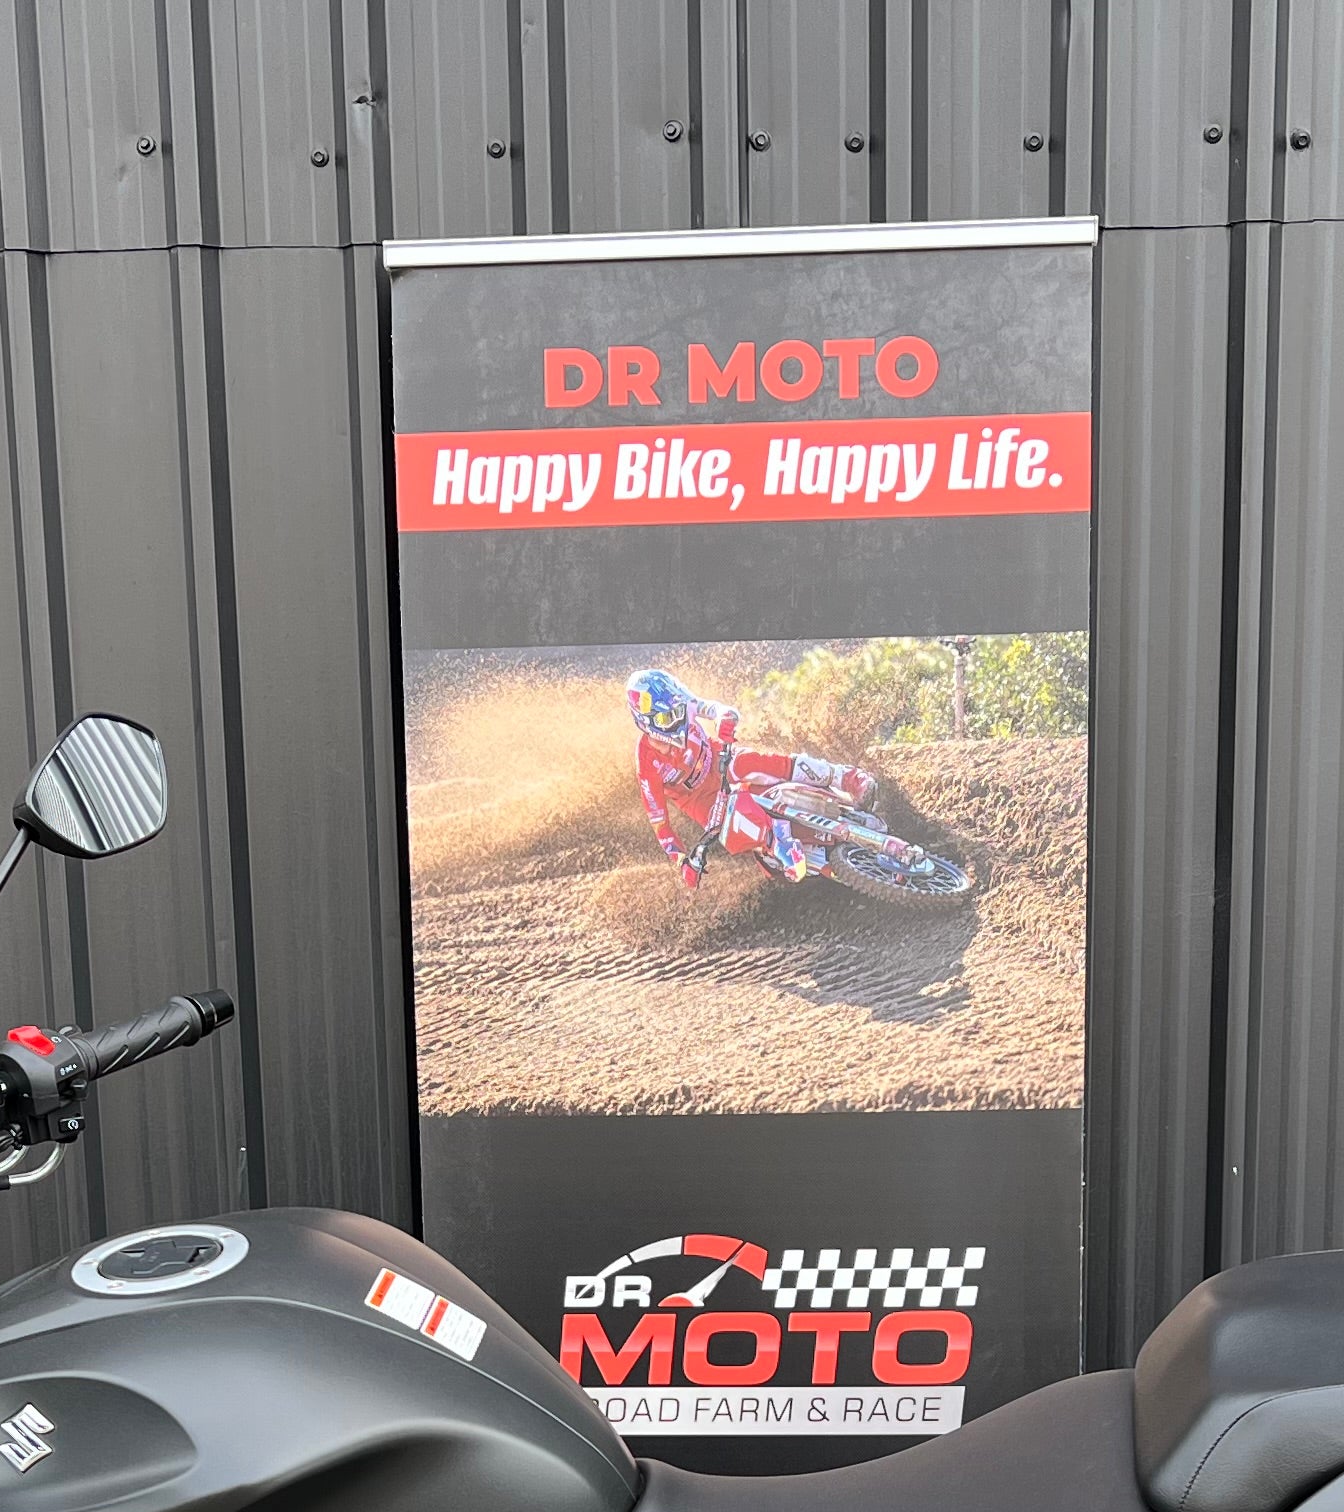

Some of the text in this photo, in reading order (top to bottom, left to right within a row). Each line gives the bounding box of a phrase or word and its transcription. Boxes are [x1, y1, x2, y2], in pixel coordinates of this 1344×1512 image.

[543, 335, 940, 409] DR MOTO
[432, 426, 1064, 513] Happy Bike, Happy Life.
[563, 1275, 652, 1308] DR
[558, 1310, 975, 1386] MOTO
[693, 1396, 794, 1423] FARM
[807, 1396, 831, 1422] &
[842, 1395, 943, 1422] RACE
